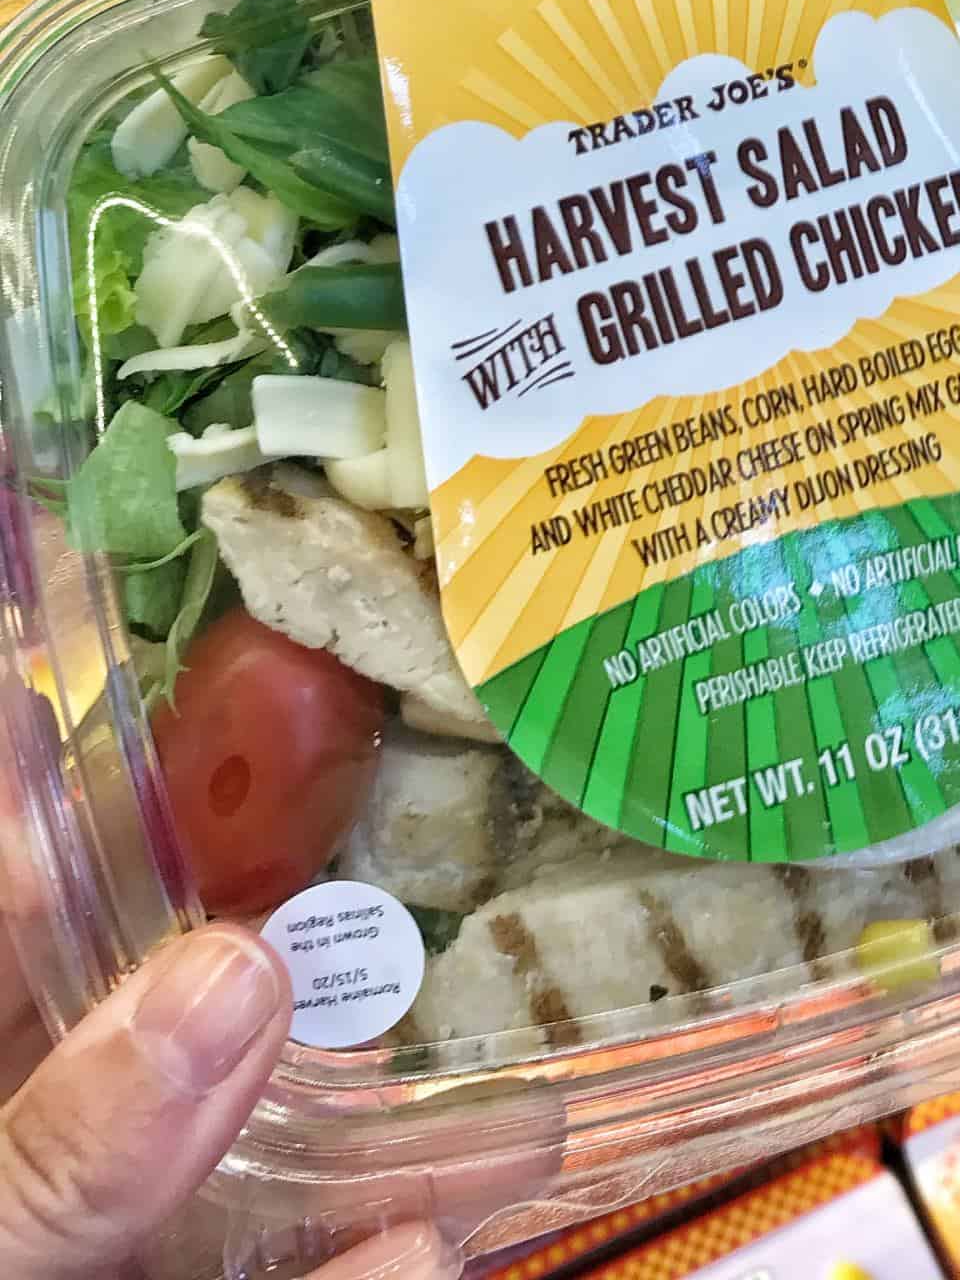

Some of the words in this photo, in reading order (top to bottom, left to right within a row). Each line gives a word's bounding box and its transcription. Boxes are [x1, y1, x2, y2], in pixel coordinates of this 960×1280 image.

[568, 95, 701, 156] TRADER
[483, 149, 727, 294] HARVEST
[736, 94, 908, 209] SALAD
[461, 311, 567, 412] WITH
[576, 236, 785, 366] GRILLED
[543, 448, 609, 499] FRESH
[608, 426, 674, 475] GREEN
[671, 404, 744, 454] BEANS,
[741, 383, 805, 430] CORN,
[801, 362, 858, 408] HARD
[857, 338, 926, 389] BOILED
[529, 514, 573, 557] AND
[572, 488, 643, 539] WHITE
[640, 456, 737, 516] CHEDDAR
[735, 430, 806, 482] CHEESE
[803, 419, 838, 457] ON
[836, 394, 906, 447] SPRING
[905, 379, 948, 421] MIX
[630, 519, 693, 569] WITH
[694, 515, 715, 549] A
[709, 483, 792, 541] CREAMY
[793, 462, 854, 512] DIJON
[851, 430, 943, 490] DRESSING
[602, 648, 638, 690] NO
[636, 608, 732, 676] ARTIFICIAL
[728, 582, 803, 635] COLORS
[830, 563, 861, 599] NO
[864, 535, 957, 592] ARTIFICIAL
[804, 637, 848, 680] KEEP
[683, 775, 749, 832] NET
[753, 757, 816, 808] WT.
[818, 742, 857, 787] 11
[863, 724, 909, 773] OZ
[286, 913, 336, 934] Region
[333, 925, 380, 945] Grown
[336, 904, 385, 923] Salinas
[290, 939, 316, 953] the
[316, 934, 331, 948] in
[311, 967, 370, 991] 5/15/20
[341, 982, 402, 1004] Romaine
